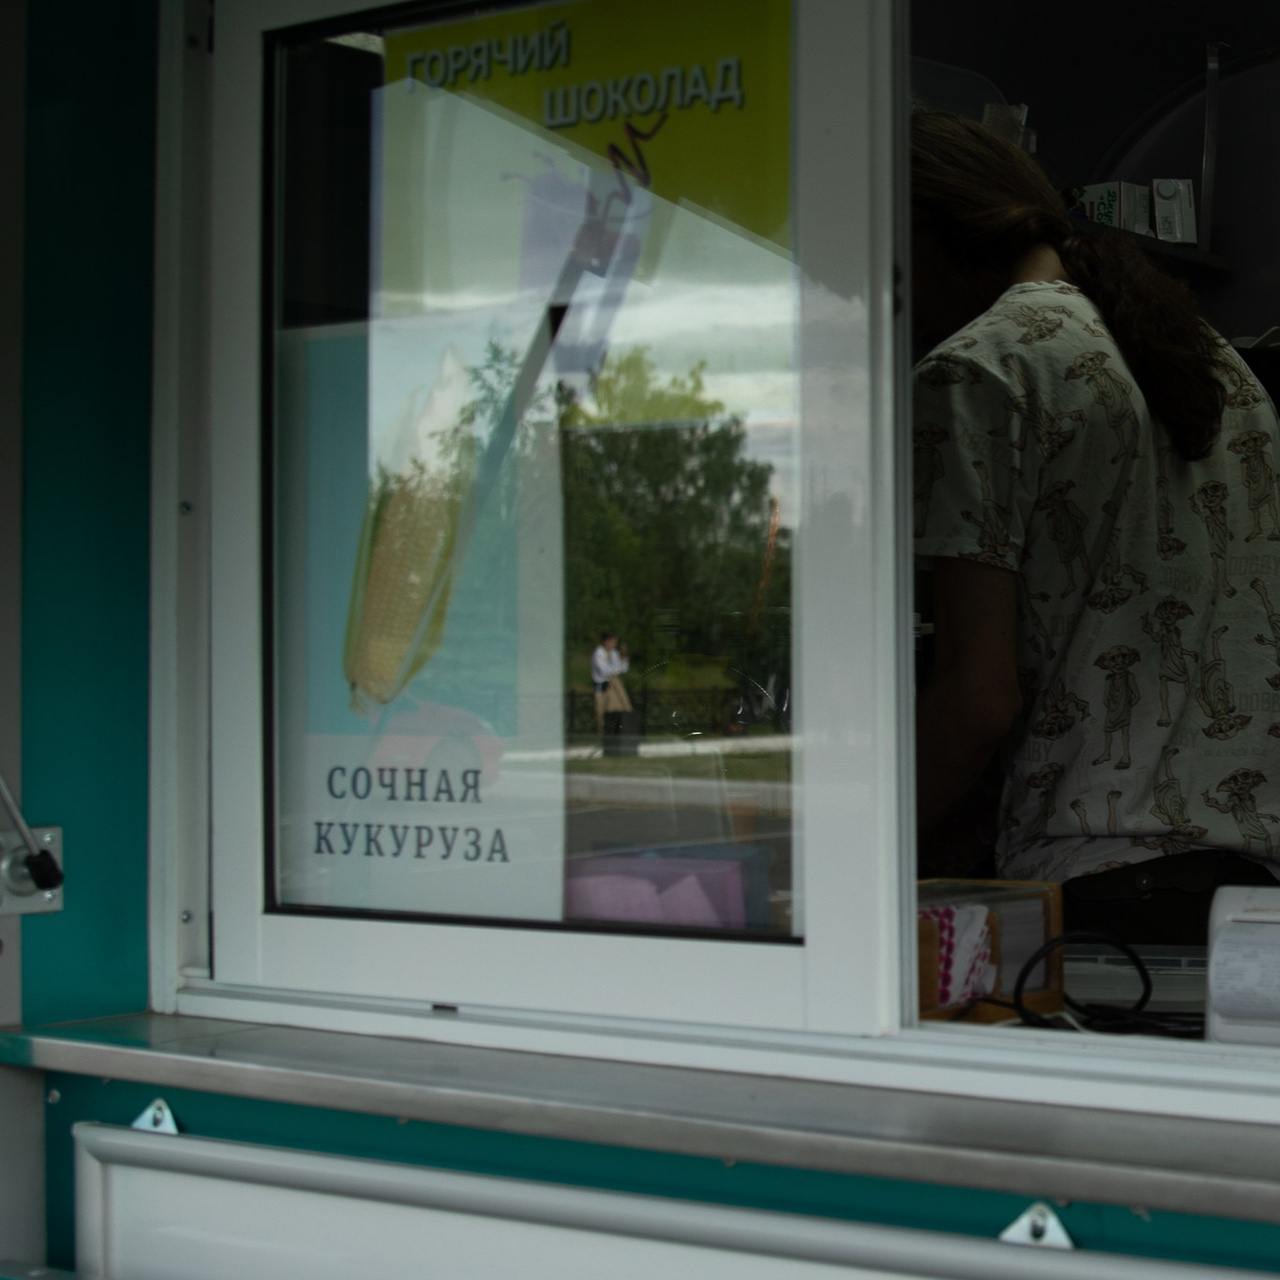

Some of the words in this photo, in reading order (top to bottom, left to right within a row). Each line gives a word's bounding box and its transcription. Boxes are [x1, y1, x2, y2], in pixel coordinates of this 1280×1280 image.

[404, 20, 570, 92] ГОРЯЧИЙ
[542, 55, 743, 128] ШОКОЛАД
[328, 766, 482, 803] СОЧНАЯ
[314, 821, 510, 863] КУКУРУЗА
